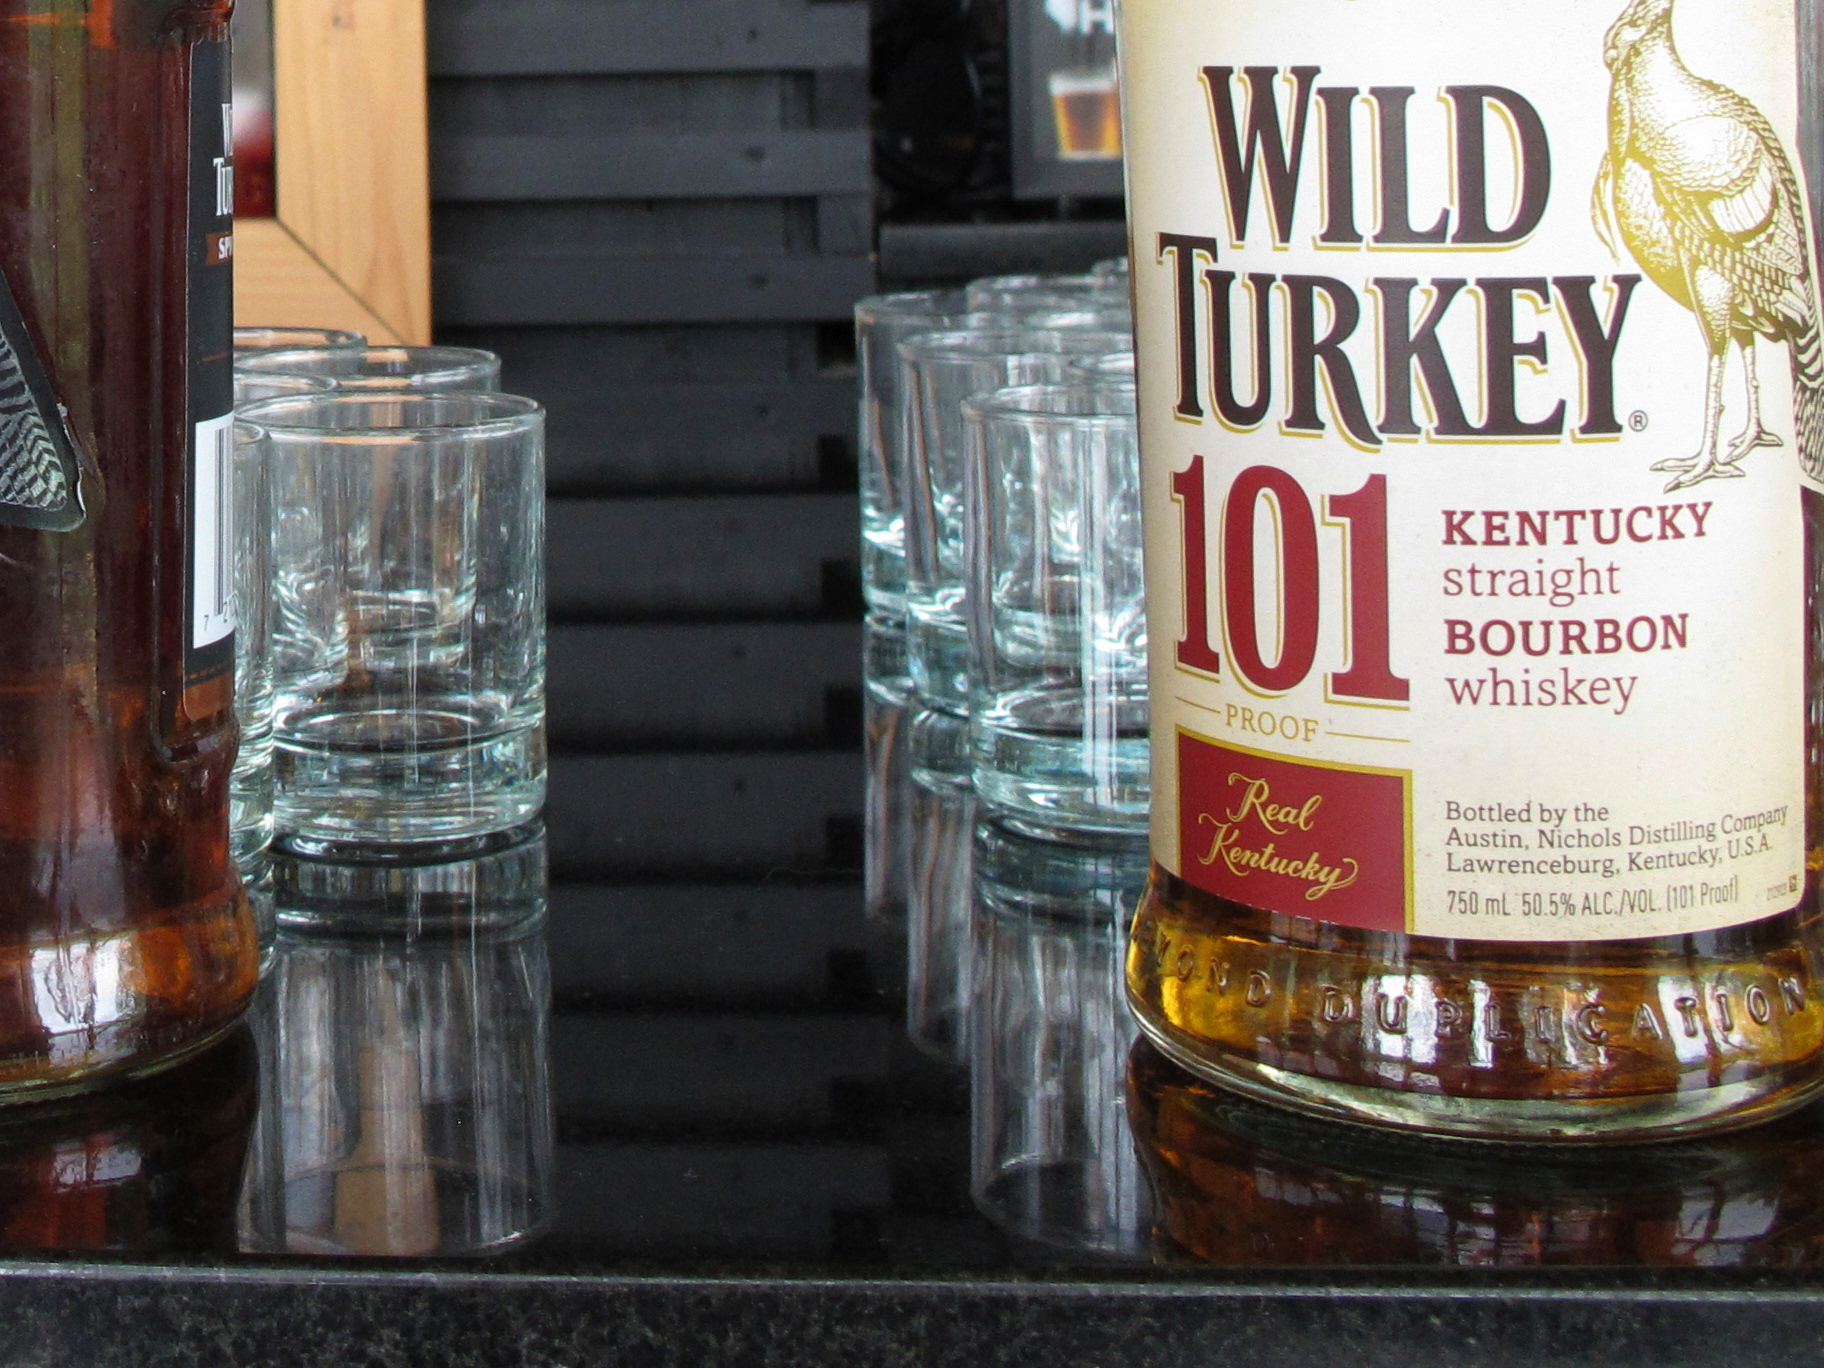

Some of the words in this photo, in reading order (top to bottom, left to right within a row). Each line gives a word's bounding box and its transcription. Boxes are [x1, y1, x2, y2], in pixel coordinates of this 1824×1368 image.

[1198, 64, 1552, 253] WILD
[1155, 231, 1643, 453] TURKEY
[1440, 501, 1715, 547] KENTUCKY
[1169, 453, 1411, 711] 101
[1441, 557, 1622, 608] straight
[1443, 613, 1691, 657] BOURBON
[1448, 667, 1640, 715] whiskey
[1224, 702, 1321, 743] PROOF
[1227, 771, 1323, 835] Real
[1445, 800, 1534, 826] Bottled
[1539, 802, 1569, 830] by
[1574, 801, 1610, 824] the
[1445, 827, 1530, 853] Austin,
[1536, 825, 1623, 850] Nichols
[1627, 817, 1718, 850] Distilling
[1720, 802, 1790, 839] Company
[1197, 811, 1359, 902] Kentucky
[1446, 850, 1622, 880] Lawrenceburg,
[1627, 844, 1724, 874] Kentucky,
[1727, 832, 1775, 860] U.S.A.
[1447, 889, 1479, 917] 750
[1521, 890, 1577, 918] 50.5%
[1581, 887, 1661, 917] ALC./VOL.
[1666, 881, 1696, 912] (101
[1699, 876, 1740, 910] Proof)
[1322, 975, 1806, 1046] DUPLICATION
